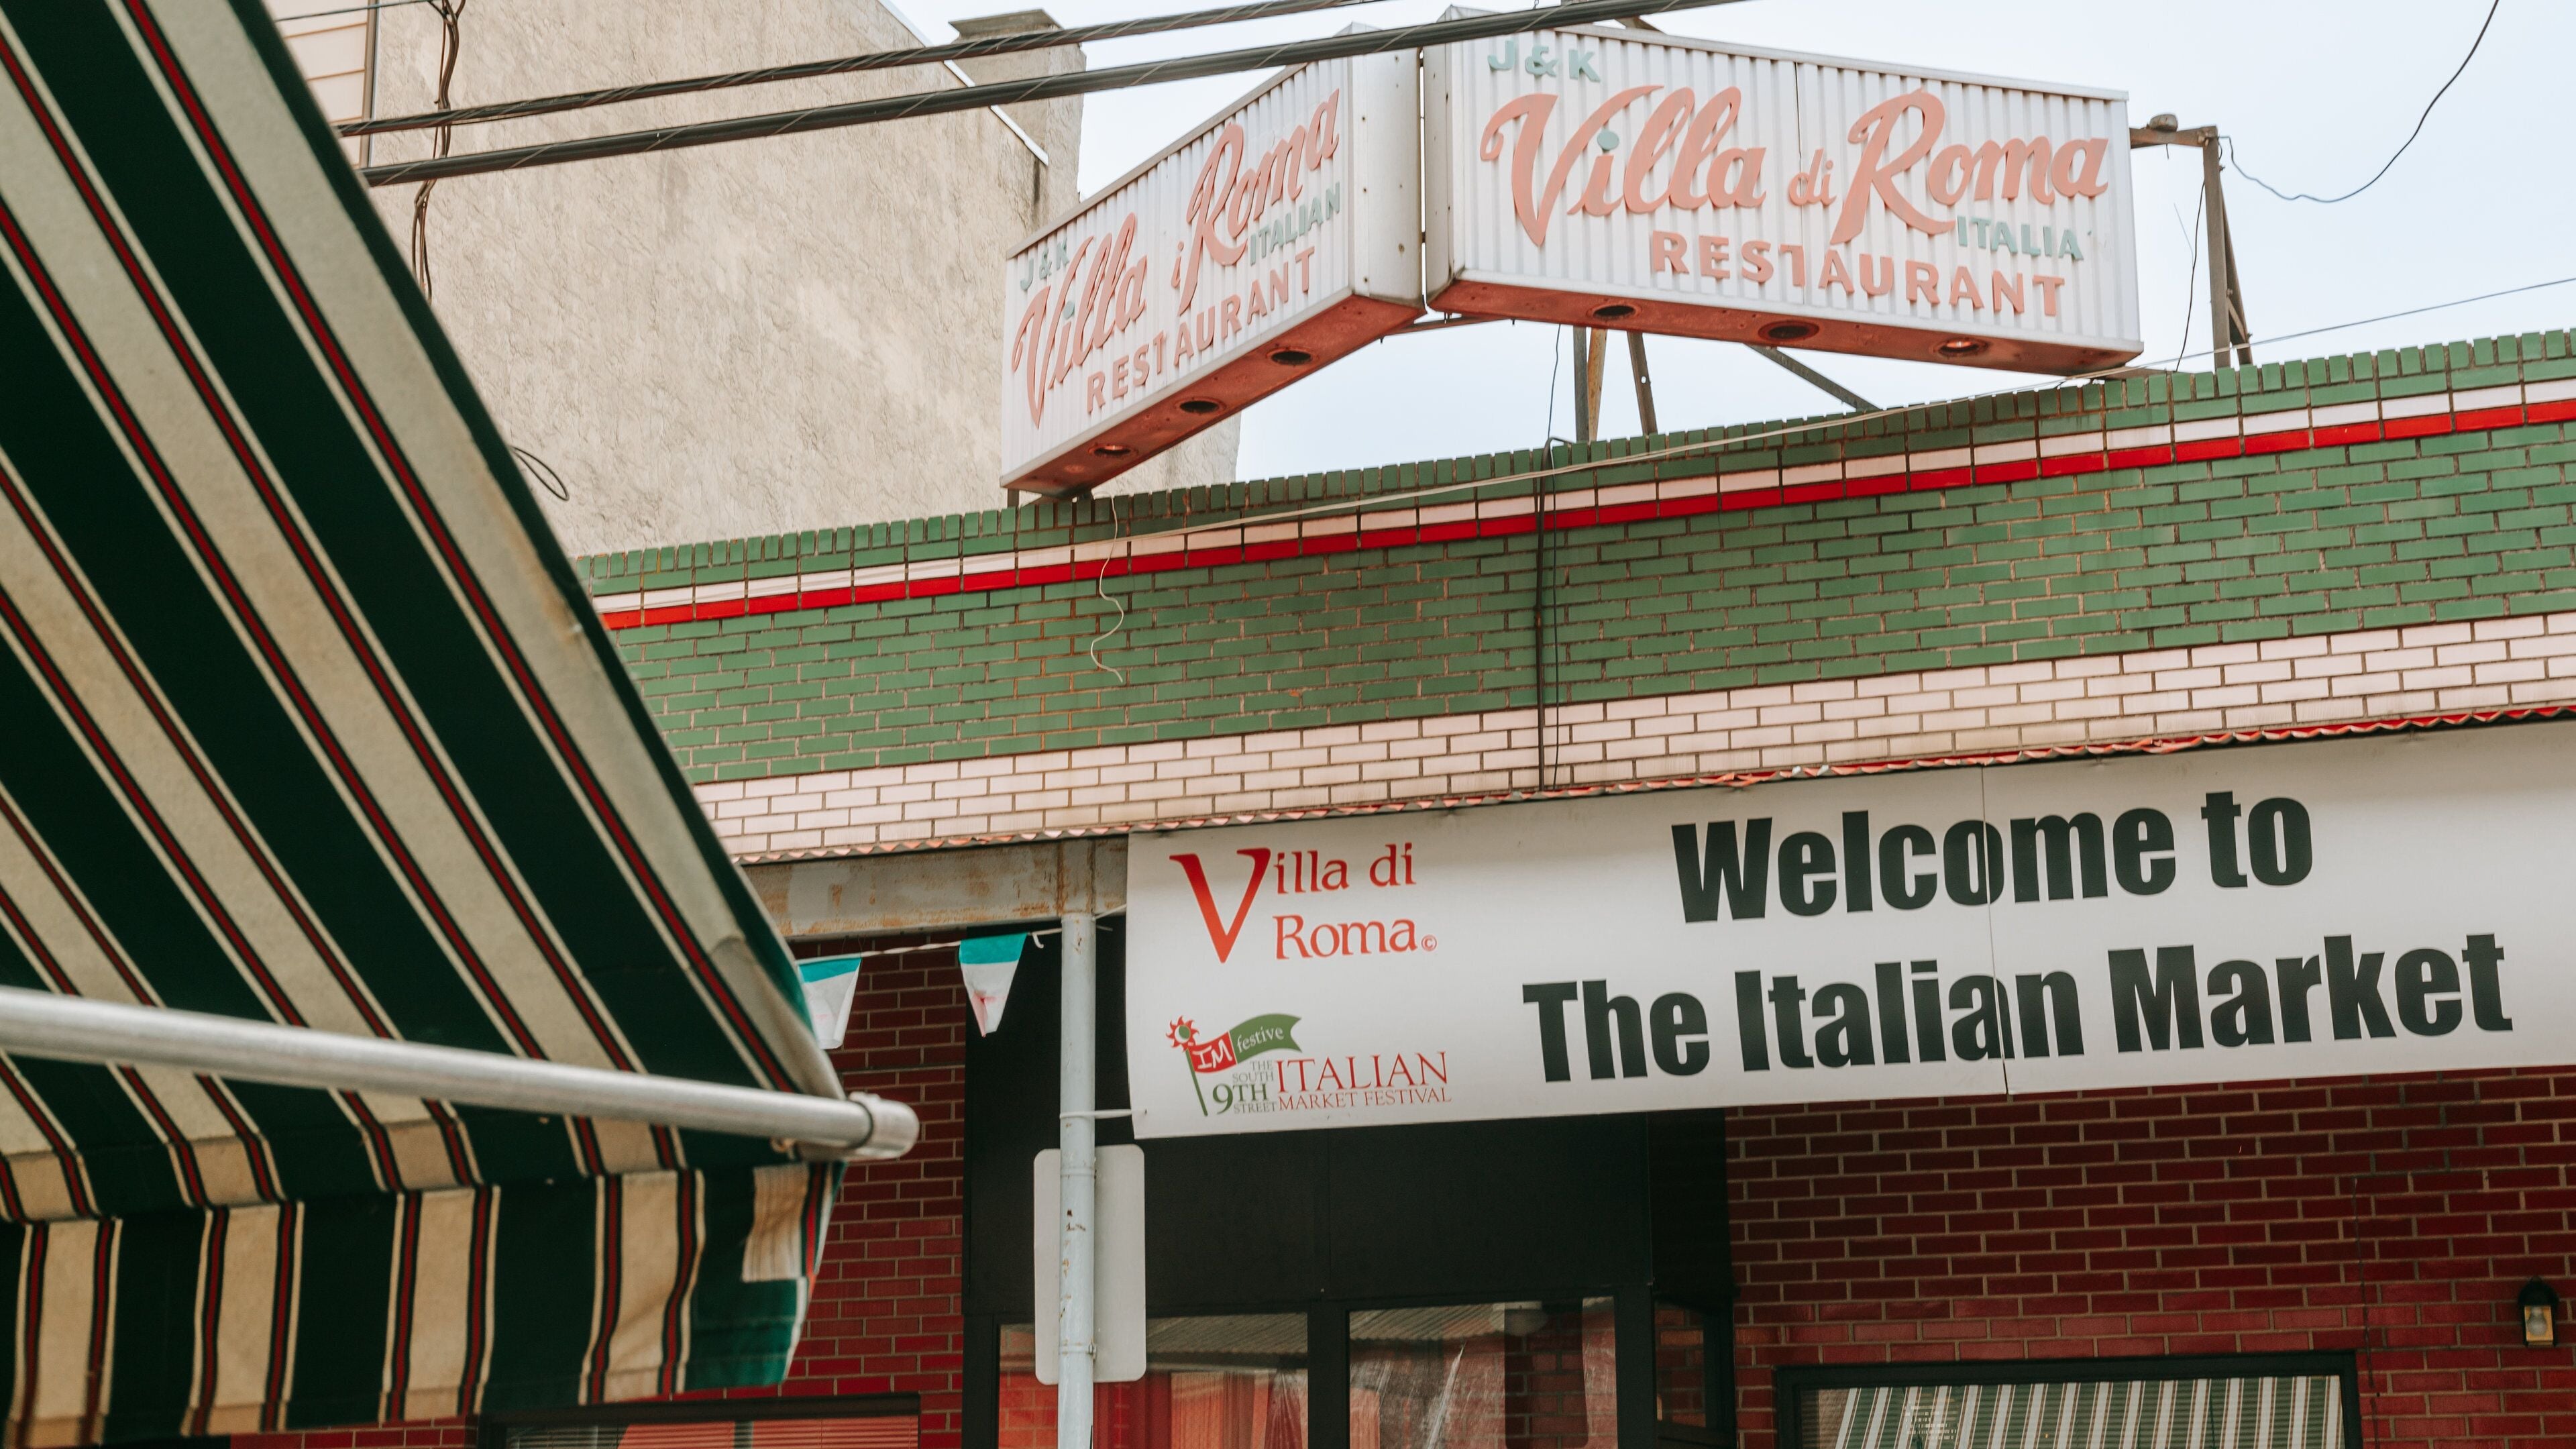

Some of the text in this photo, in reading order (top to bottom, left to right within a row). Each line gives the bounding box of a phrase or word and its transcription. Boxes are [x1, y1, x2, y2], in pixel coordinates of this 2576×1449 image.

[1479, 85, 2108, 246] Villa di Roma
[1249, 182, 1340, 265] ITALIAN
[1012, 213, 1148, 429] Villa
[1177, 89, 1339, 315] Roma
[1652, 231, 2065, 316] RESTAURANT
[1087, 246, 1316, 413] RESTAURANT
[1671, 791, 2314, 924] Welcome to
[1169, 842, 1417, 963] Villa di
[1236, 1025, 1285, 1053] festive
[1523, 933, 2514, 1083] The Italian Market
[1192, 1039, 1233, 1070] IM
[1232, 1071, 1274, 1083] SOUTH
[1250, 1060, 1273, 1072] THE
[1275, 1051, 1448, 1093] ITALIAN
[1212, 1083, 1267, 1115] 9TH
[1234, 1102, 1277, 1114] STREET
[1279, 1087, 1452, 1111] MARKET FESTIVAL
